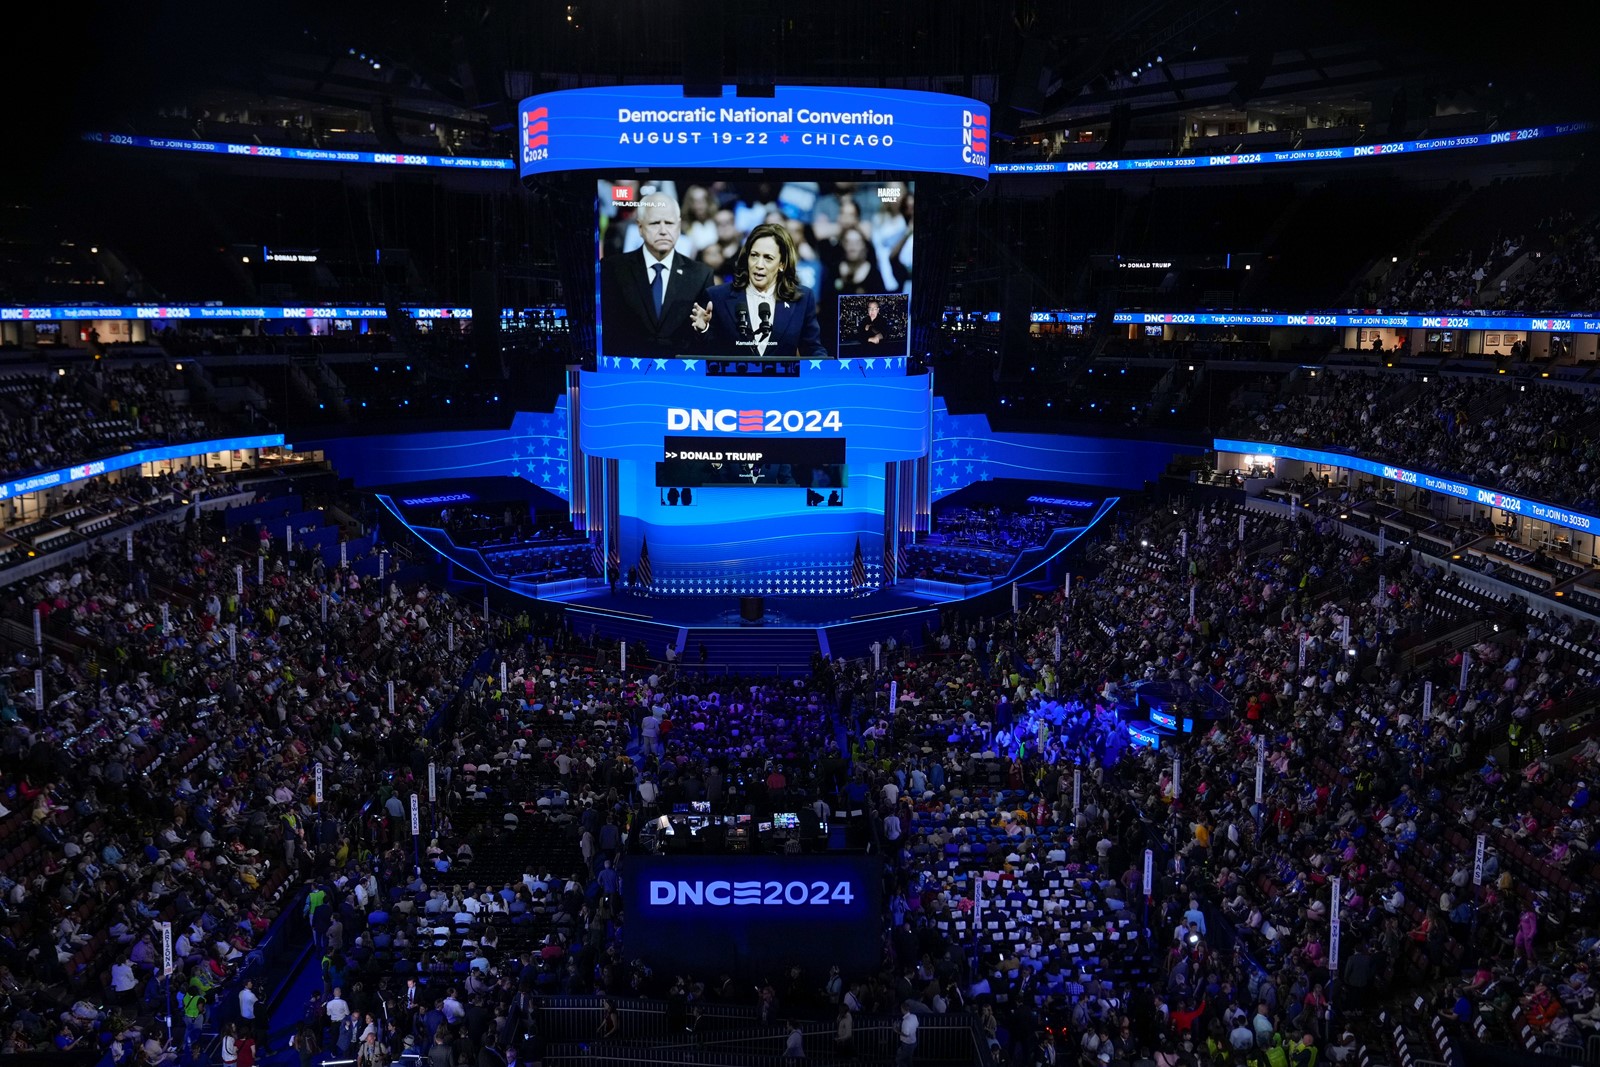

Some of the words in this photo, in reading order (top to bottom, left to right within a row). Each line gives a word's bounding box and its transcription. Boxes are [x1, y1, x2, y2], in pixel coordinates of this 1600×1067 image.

[618, 107, 716, 124] Democratic
[720, 108, 793, 125] National
[797, 109, 893, 126] Convention
[110, 134, 133, 145] 2024
[619, 132, 701, 145] AUGUST
[712, 133, 769, 145] 19-22
[801, 133, 893, 147] CHICAGO
[1490, 132, 1511, 143] DNC
[1517, 129, 1539, 140] 2024
[149, 139, 164, 147] Text
[1430, 140, 1447, 148] JOIN
[1456, 137, 1478, 145] 30330
[228, 145, 250, 155] DNC
[258, 147, 281, 157] 2024
[529, 148, 548, 162] 2024
[1353, 146, 1374, 156] DNC
[1381, 143, 1404, 153] 2024
[374, 155, 396, 164] DNC
[404, 156, 427, 165] 2024
[972, 153, 986, 166] 2024
[1210, 156, 1230, 166] DNC
[1237, 154, 1261, 164] 2024
[1067, 162, 1088, 171] DNC
[1095, 161, 1118, 171] 2024
[616, 189, 628, 198] LIVE
[877, 187, 900, 198] HARRIS
[137, 308, 159, 318] DNC
[166, 308, 190, 318] 2024
[283, 308, 305, 318] DNC
[313, 308, 337, 318] 2024
[419, 309, 441, 318] DNC
[450, 309, 472, 318] 024
[1144, 314, 1165, 323] DNC
[1172, 314, 1195, 323] 2024
[1287, 316, 1307, 325] DNC
[1314, 316, 1337, 325] 2024
[1422, 318, 1441, 327] DNC
[1447, 318, 1469, 327] 2024
[1532, 319, 1548, 330] DNC
[1553, 320, 1571, 330] 2024
[1584, 321, 1596, 330] Text
[667, 408, 737, 431] DNC
[765, 410, 842, 432] 2024
[680, 451, 723, 460] DONALD
[725, 452, 763, 461] TRUMP
[1384, 466, 1398, 479] DNC
[1401, 471, 1417, 484] 2024
[1425, 477, 1435, 487] Text
[1435, 480, 1447, 490] JOIN
[1478, 490, 1496, 504] DNC
[1501, 497, 1521, 511] 2024
[1532, 505, 1544, 516] Text
[1545, 509, 1561, 521] JOIN
[1562, 513, 1569, 522] to
[1569, 514, 1590, 528] 30330
[1474, 841, 1484, 879] TEXAS
[650, 880, 731, 906] DNC
[764, 881, 854, 906] 2024
